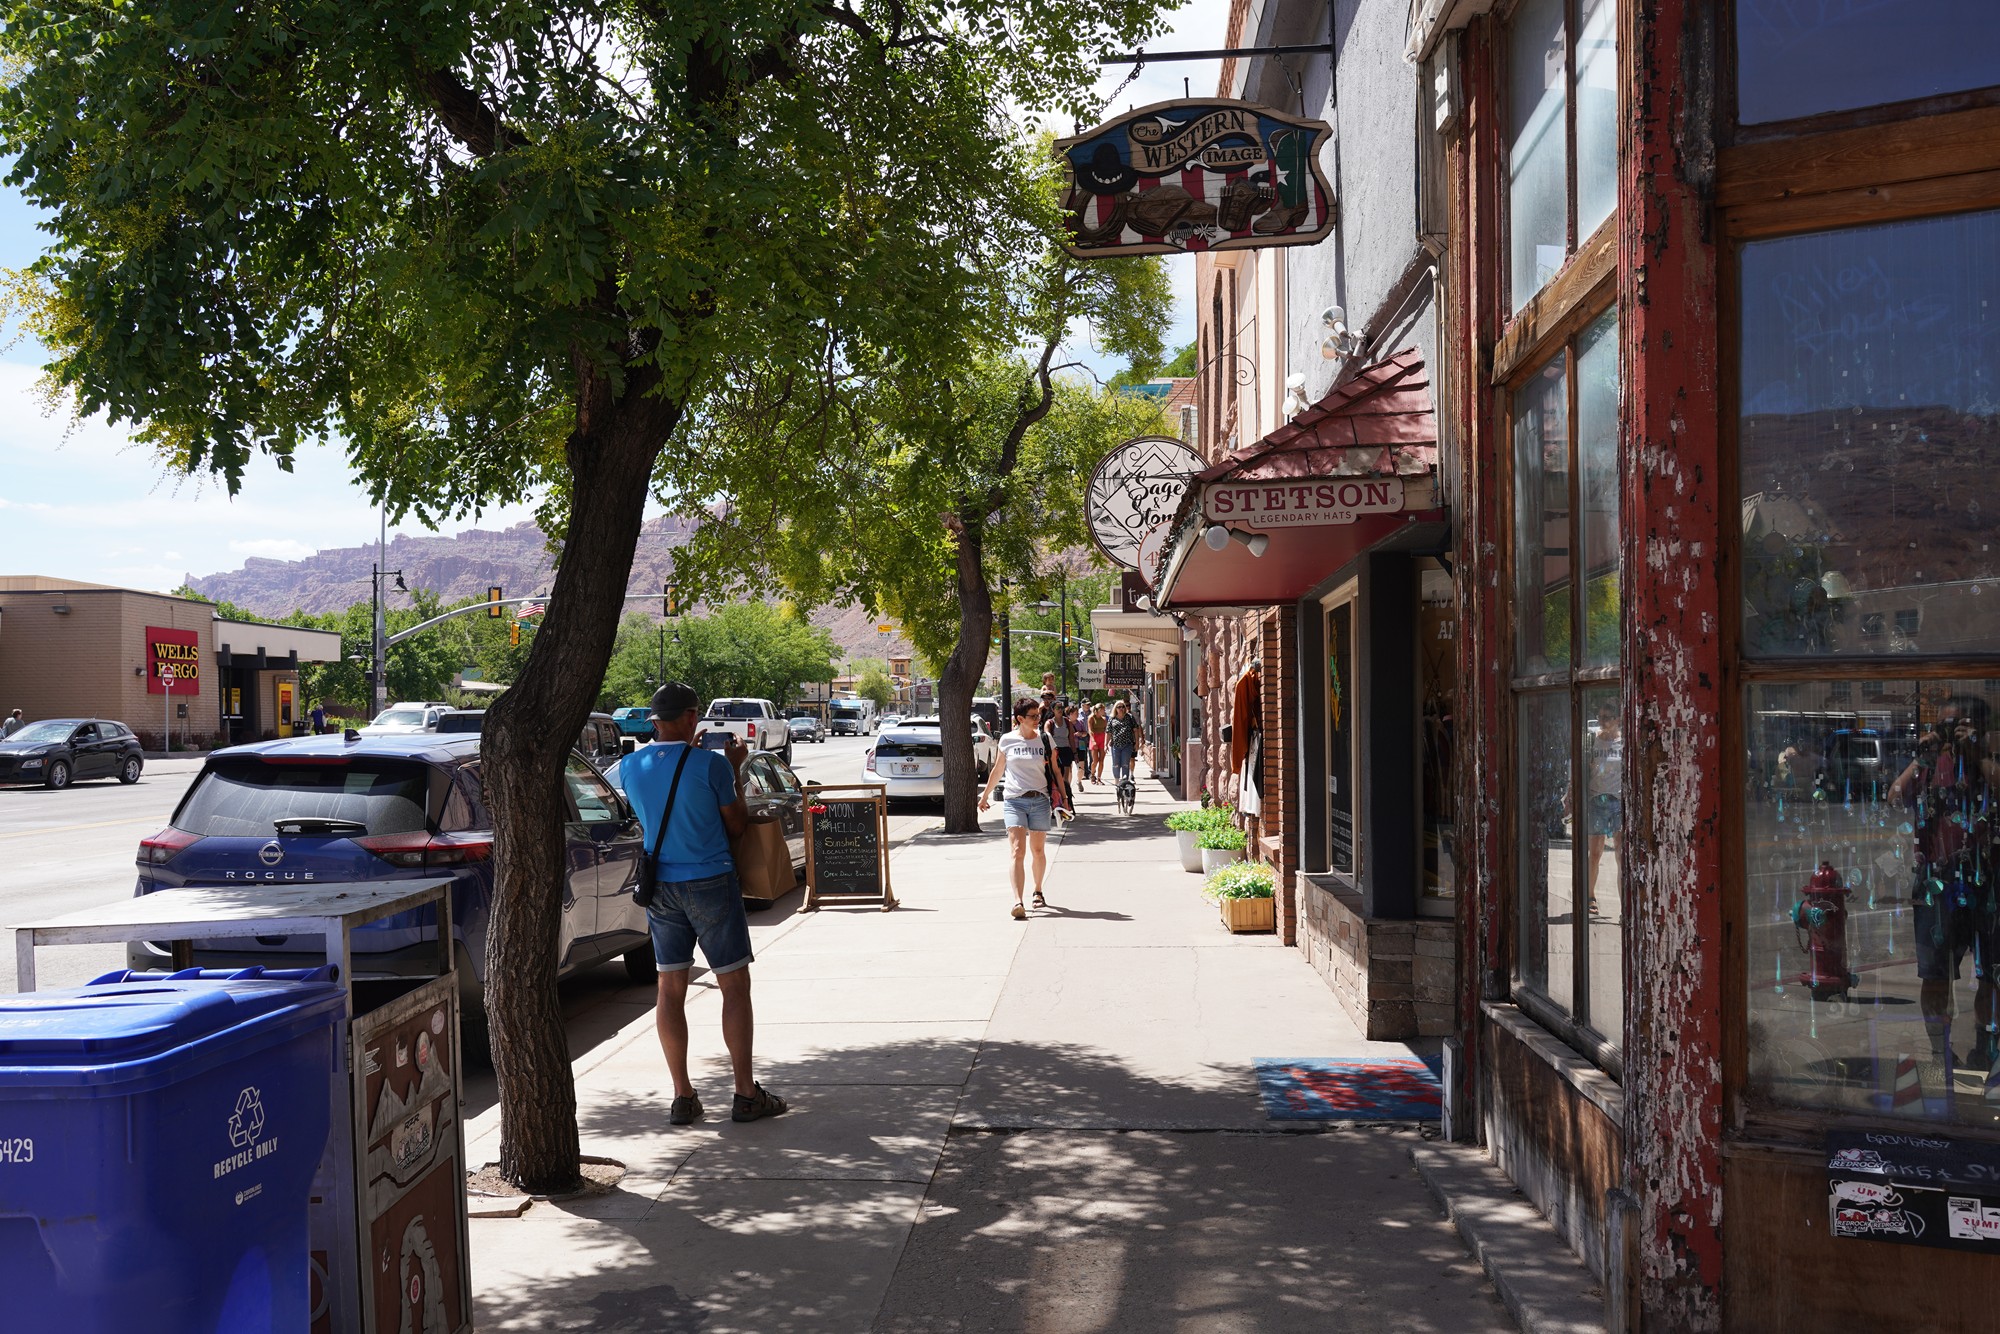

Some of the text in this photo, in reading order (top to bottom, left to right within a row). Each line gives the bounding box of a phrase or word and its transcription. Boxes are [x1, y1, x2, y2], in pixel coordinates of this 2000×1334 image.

[1134, 125, 1160, 138] The
[1141, 110, 1246, 168] WESTERN
[1206, 148, 1263, 163] IMAGE
[1128, 470, 1185, 503] Sage
[1153, 496, 1161, 509] &
[1214, 482, 1391, 514] STETSON
[1253, 511, 1352, 524] LEGENDARY HATS
[154, 642, 199, 661] WELLS
[1110, 654, 1143, 670] THE FIND
[156, 661, 199, 679] FRGO
[828, 803, 855, 818] MOON
[830, 822, 866, 833] HELLO
[225, 871, 314, 880] ROGUE
[214, 1136, 278, 1179] RECYCLE ONLY
[1832, 1160, 1883, 1168] REDROCK
